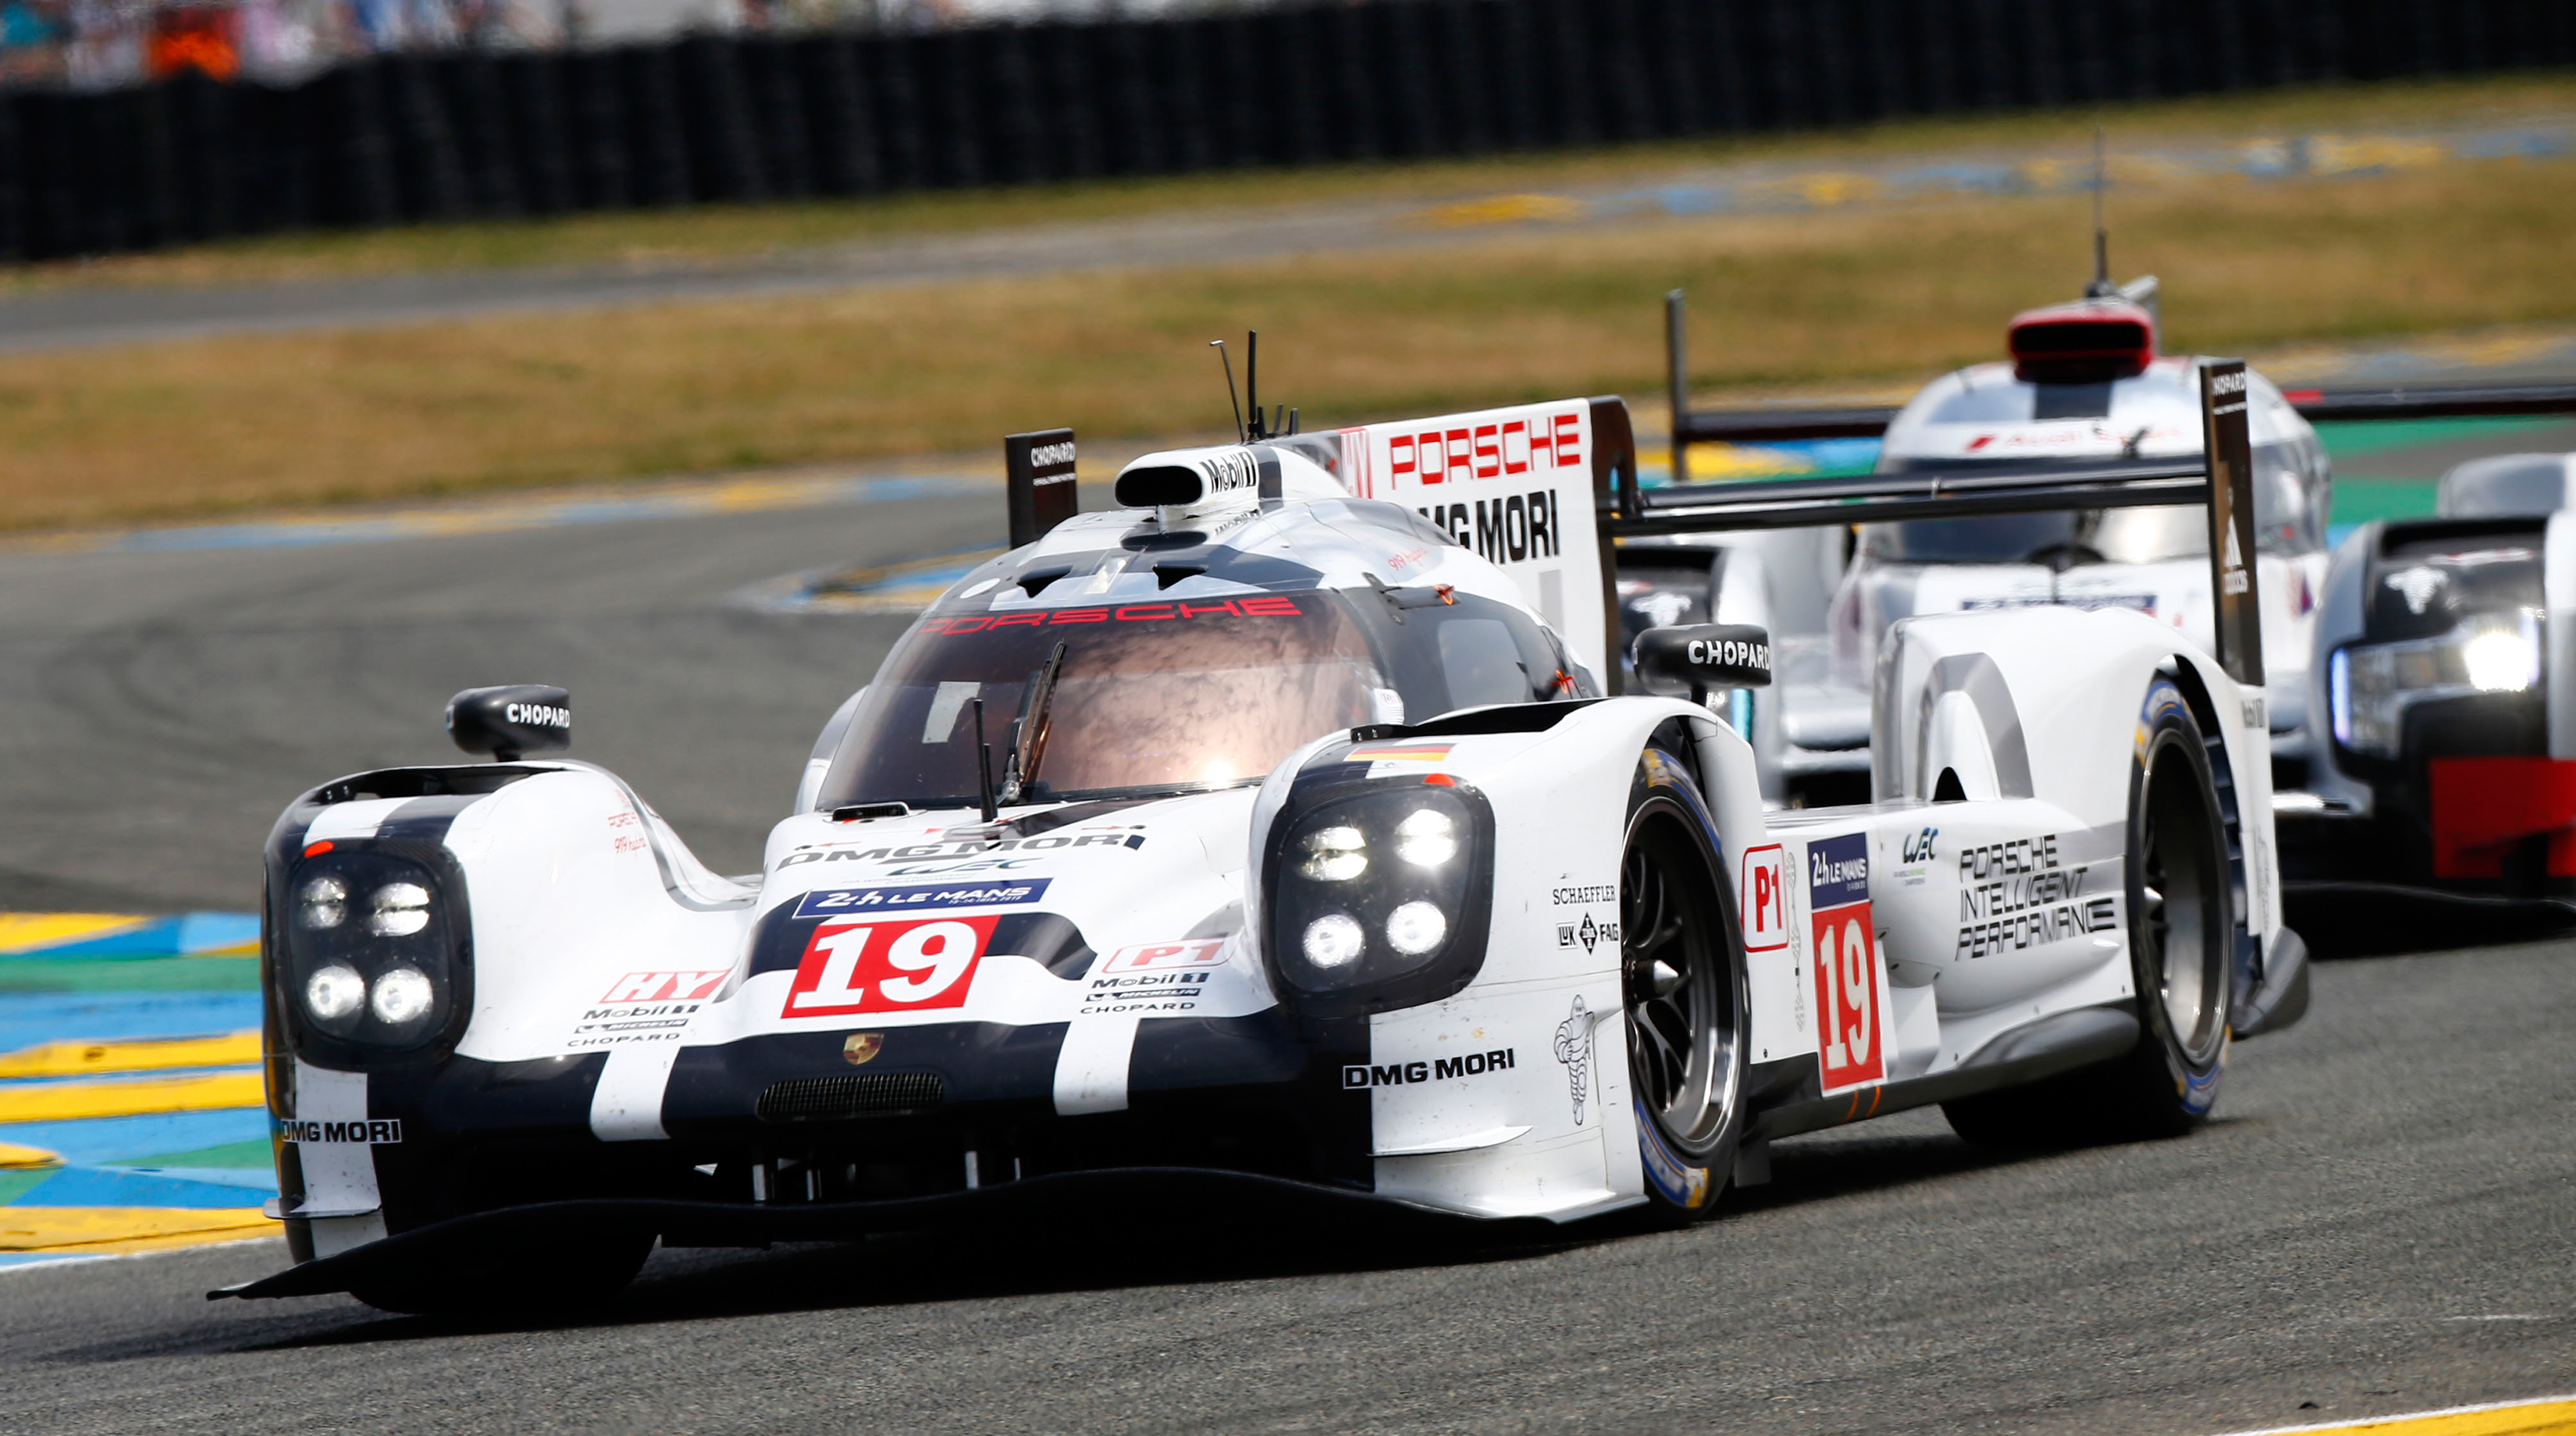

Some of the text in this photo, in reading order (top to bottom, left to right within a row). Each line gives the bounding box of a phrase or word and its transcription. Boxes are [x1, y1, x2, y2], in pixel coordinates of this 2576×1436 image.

[1031, 442, 1076, 467] CHOPARD
[1389, 414, 1580, 489] PORSCHE
[1199, 454, 1244, 494] Mobil
[1476, 489, 1560, 565] MORI
[913, 597, 1301, 637] PORSCHE
[1688, 640, 1771, 670] CHOPARD
[507, 703, 571, 728] CHOPARD
[776, 834, 1146, 872] DMG MORI
[1903, 826, 1938, 863] WEC
[1960, 834, 2058, 883] PORSCHE
[886, 858, 1045, 876] WEC
[1830, 862, 1841, 884] LE
[1841, 858, 1866, 883] MANS
[887, 893, 933, 904] LE
[933, 887, 1032, 901] MANS
[1553, 885, 1616, 905] SCHAEFFLER
[1755, 864, 1782, 932] P1
[1961, 866, 2088, 922] INTELLIGENT
[1599, 923, 1619, 941] FAG
[793, 921, 977, 1008] 19
[1130, 941, 1224, 966] P1
[603, 972, 726, 1002] HY
[1091, 973, 1177, 989] Mobil
[1119, 989, 1199, 1000] MICHELIN
[1820, 918, 1871, 1069] 19
[582, 1005, 667, 1019] Mobil
[1080, 1003, 1195, 1014] CHOPARD
[568, 1033, 680, 1047] CHOPARD
[1346, 1048, 1515, 1088] DMG MORI
[282, 1121, 400, 1143] DMG MORI
